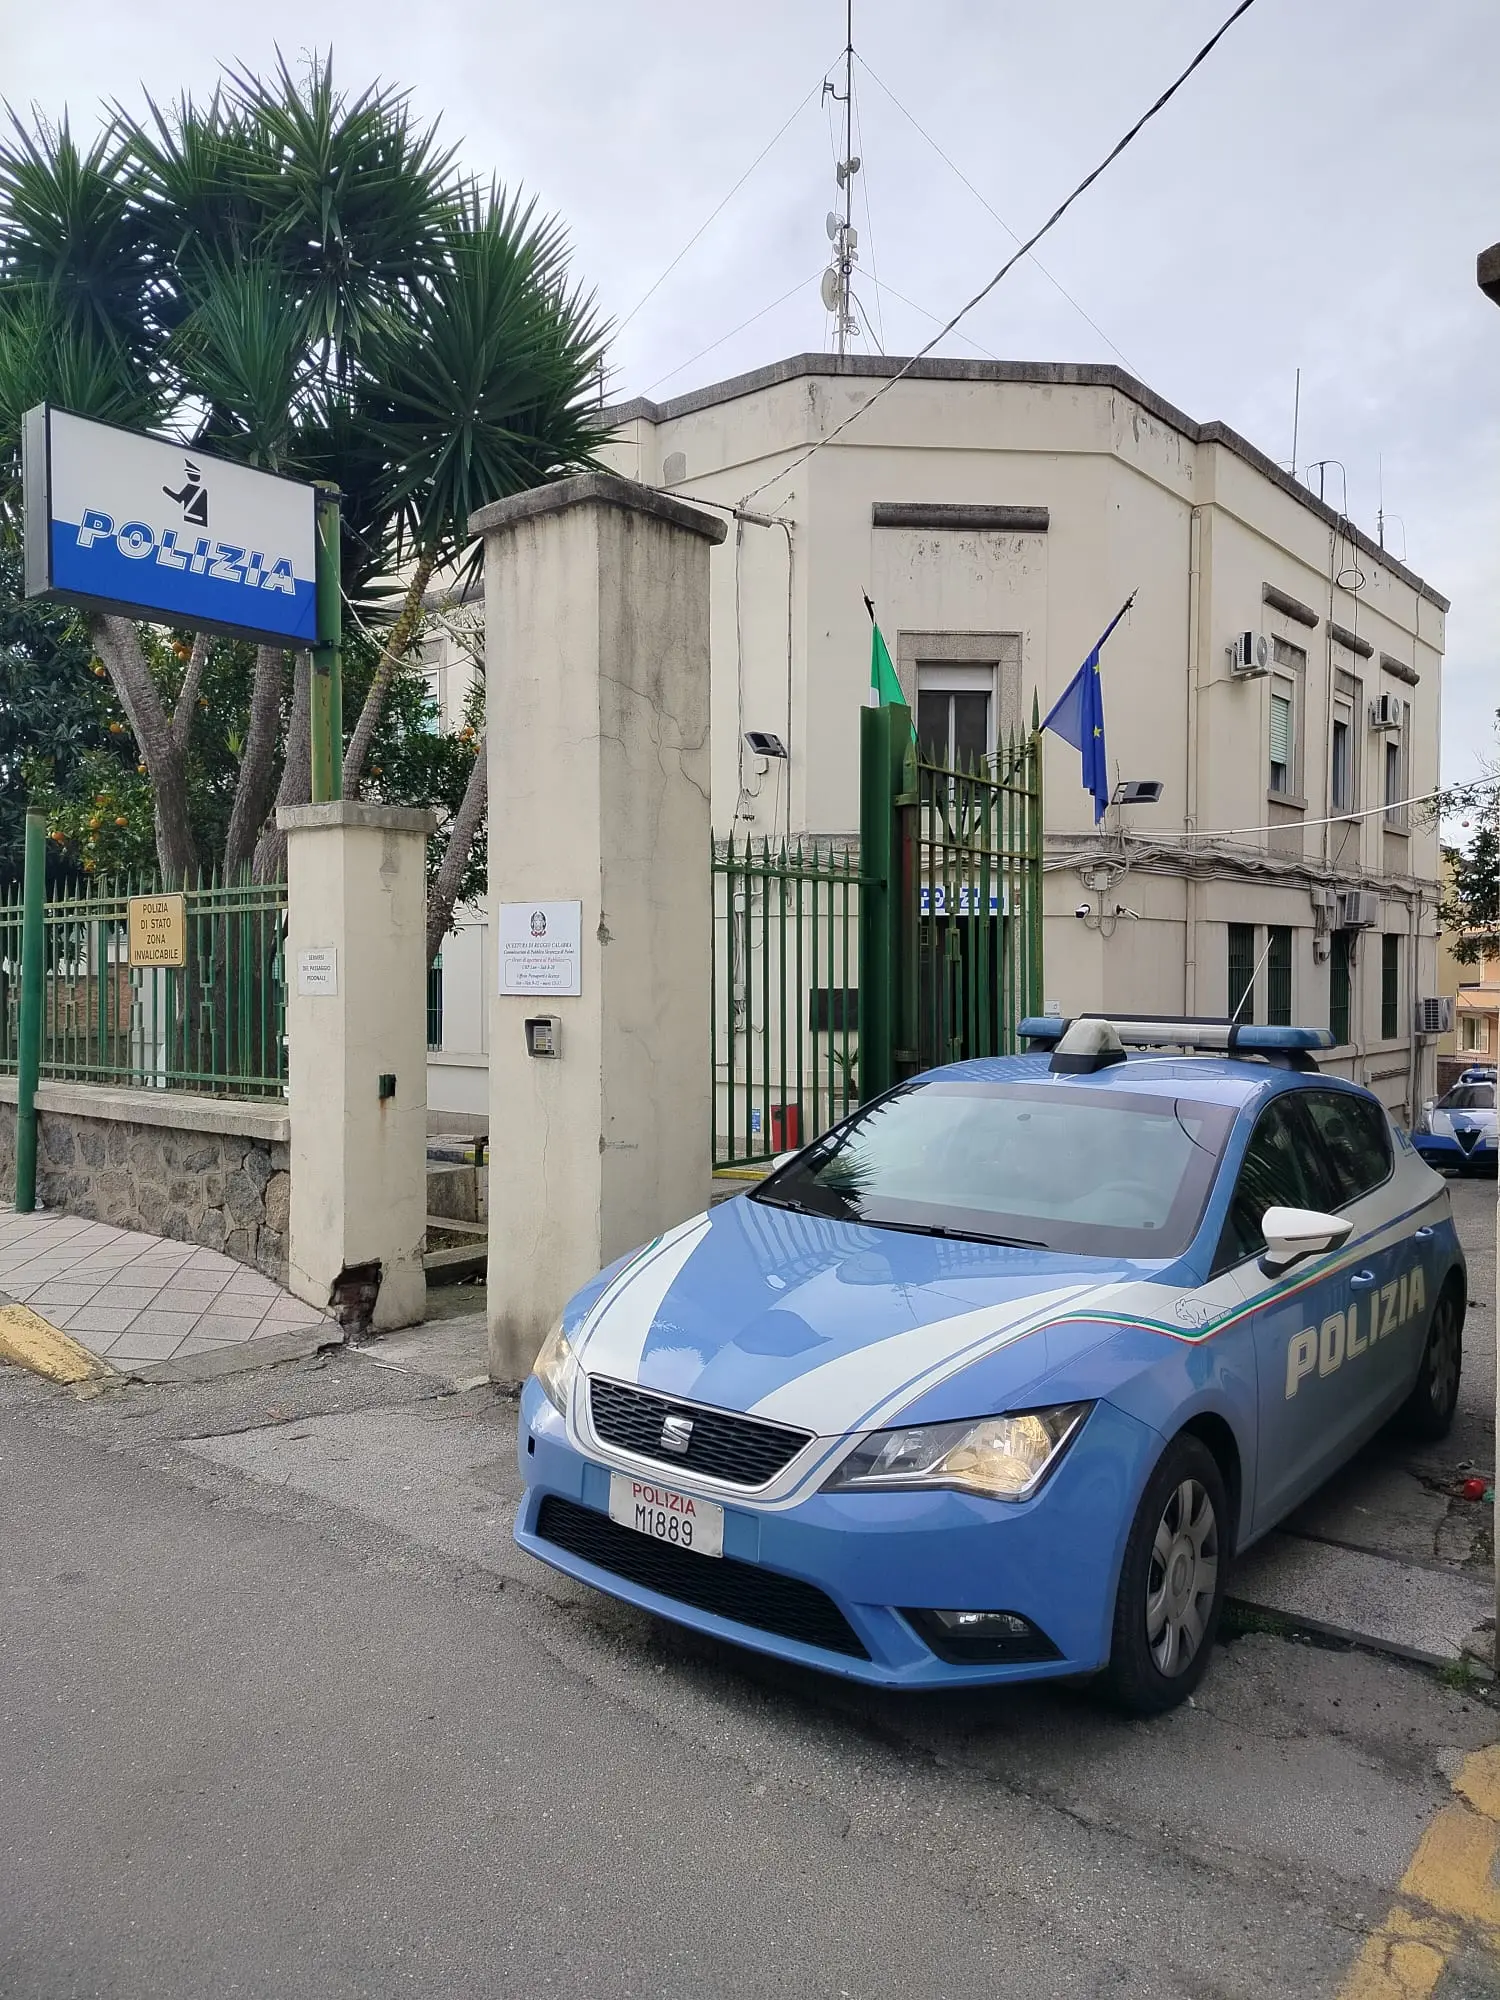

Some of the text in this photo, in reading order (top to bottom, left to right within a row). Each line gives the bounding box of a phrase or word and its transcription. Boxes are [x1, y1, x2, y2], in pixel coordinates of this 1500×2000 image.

[76, 508, 296, 595] POLIZIA
[142, 902, 169, 914] POLIZIA
[140, 917, 172, 930] DI STATO
[146, 934, 166, 945] ZONA
[134, 949, 179, 961] INVALICABILE
[1285, 1264, 1425, 1400] POLIZIA
[632, 1482, 696, 1517] POLIZIA
[635, 1503, 693, 1547] M1889
